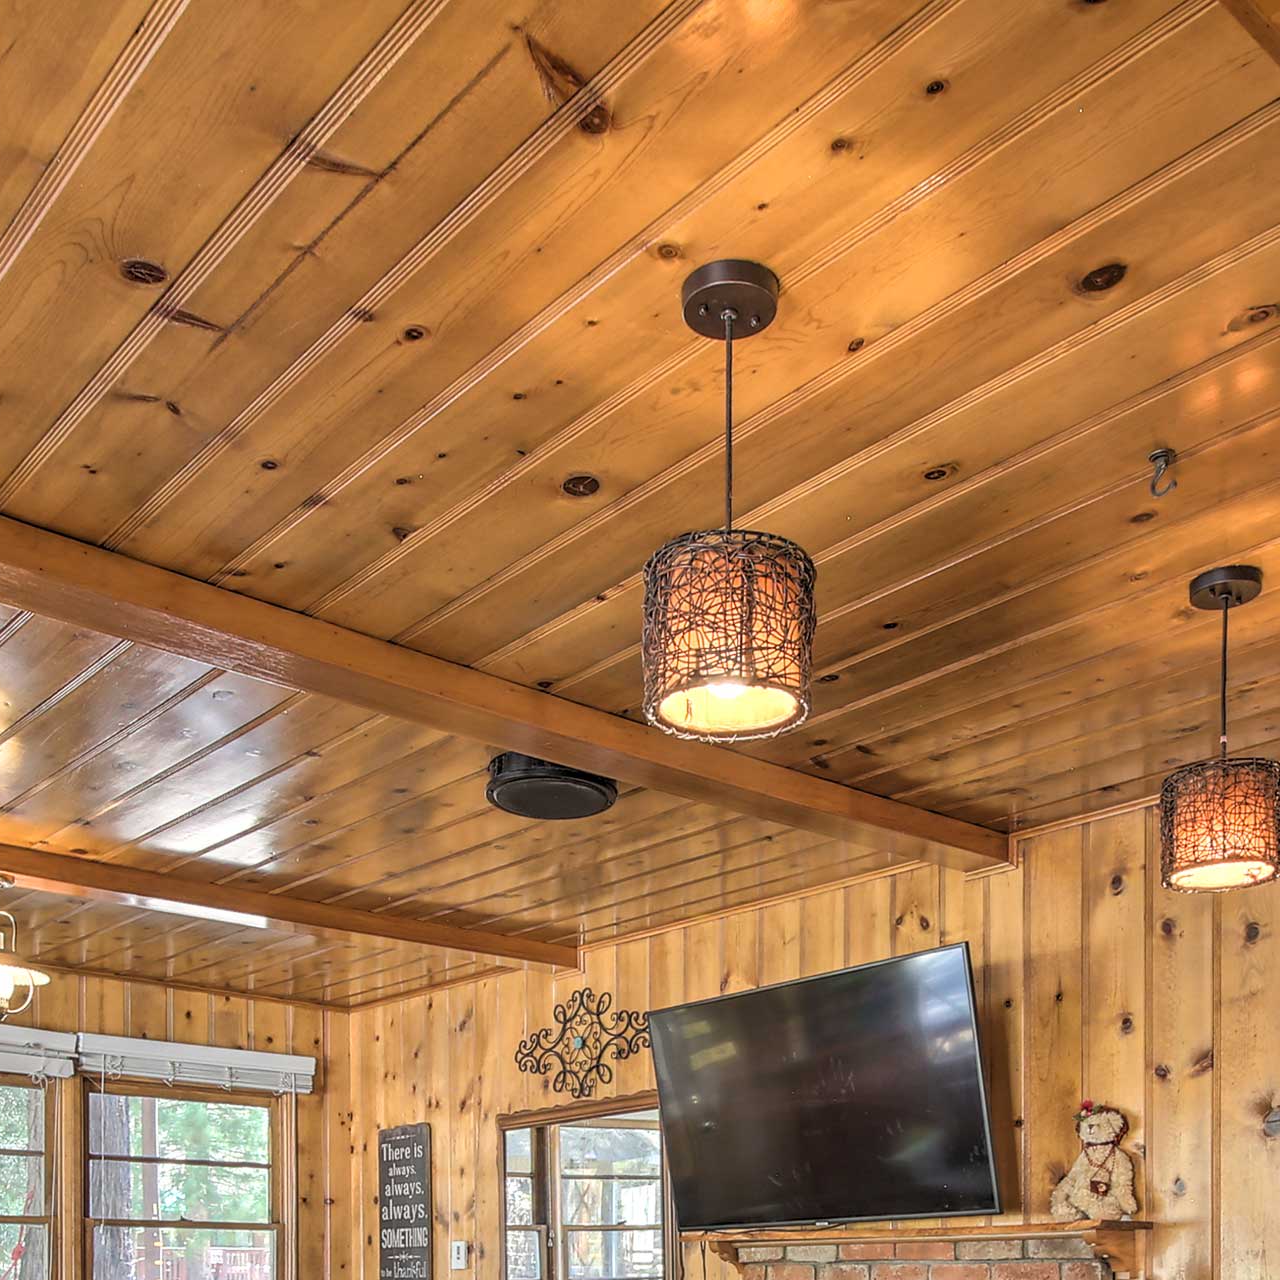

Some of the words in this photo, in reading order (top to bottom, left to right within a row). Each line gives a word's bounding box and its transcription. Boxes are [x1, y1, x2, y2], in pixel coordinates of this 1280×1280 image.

[381, 1143, 411, 1161] There
[413, 1142, 423, 1158] is
[381, 1227, 428, 1248] SOMETHING
[393, 1261, 427, 1279] thankful
